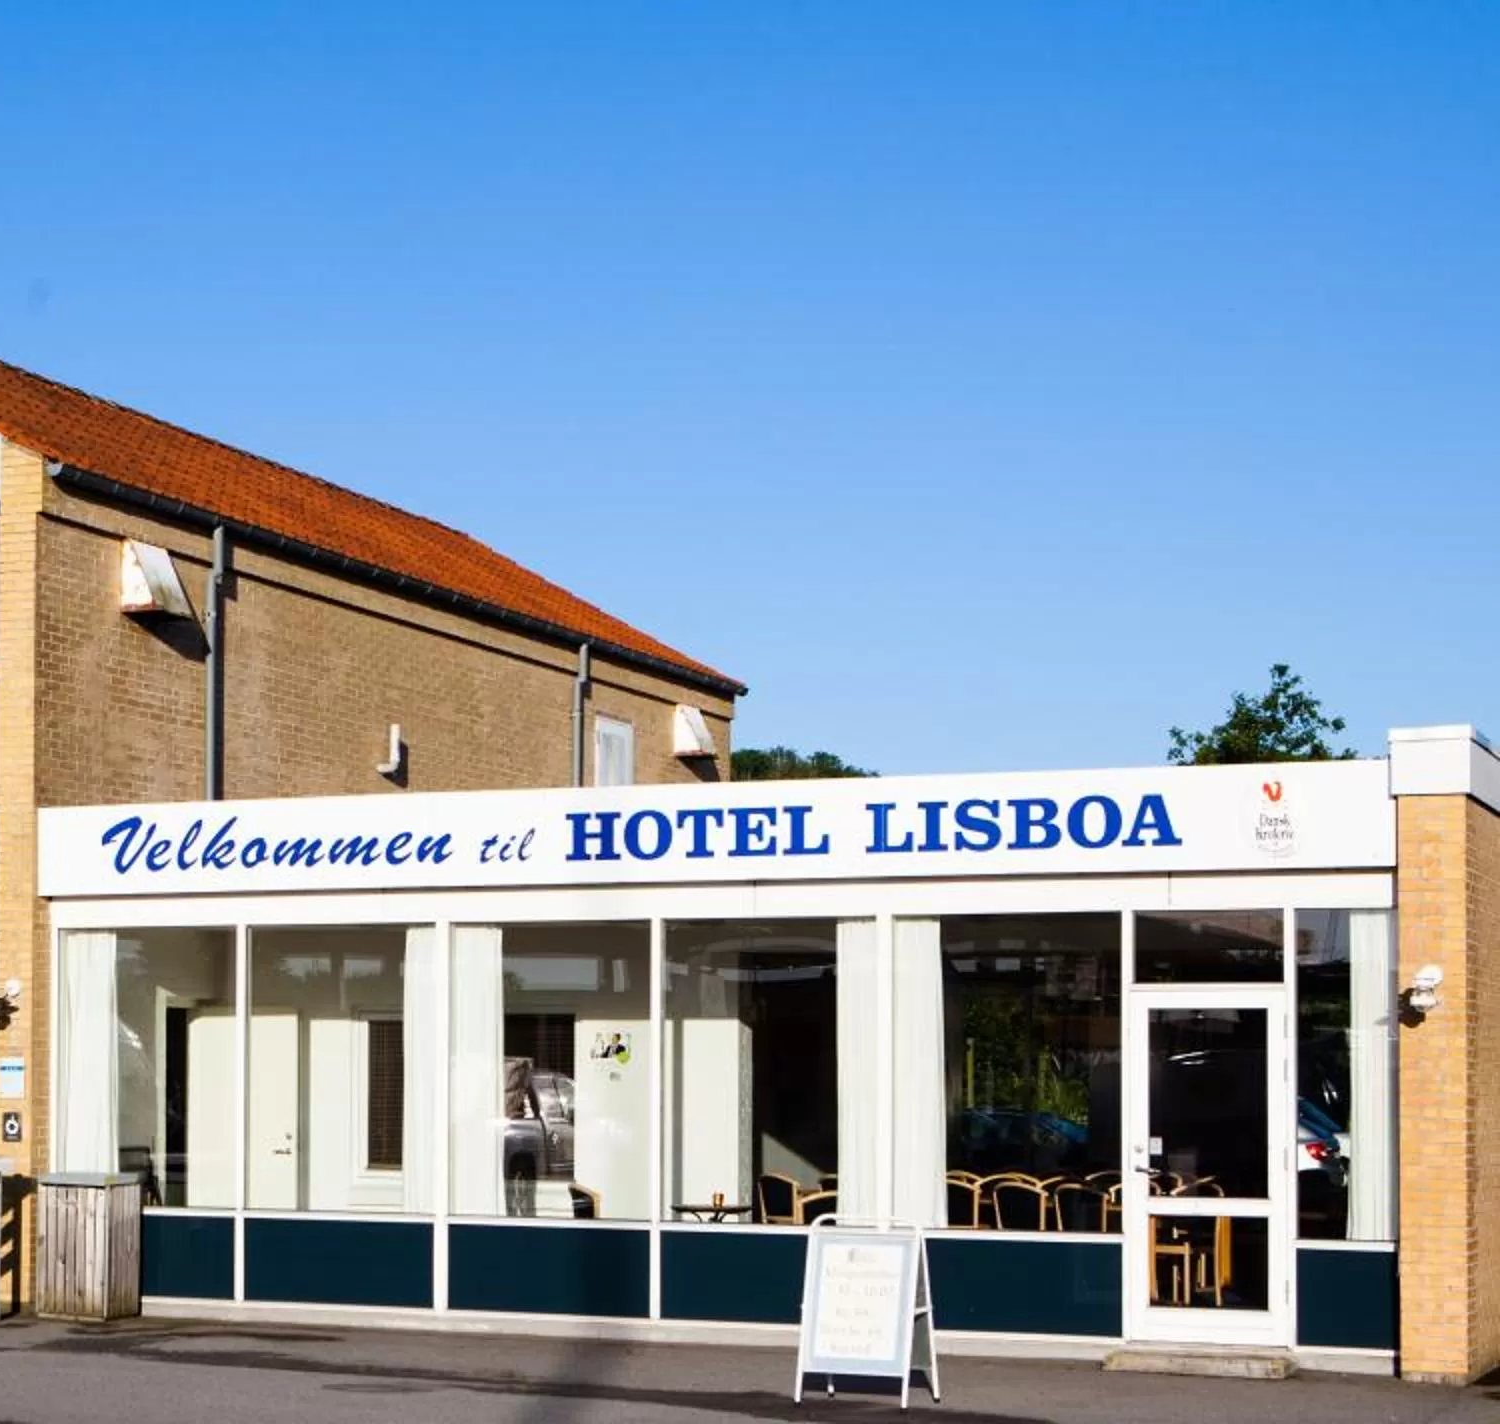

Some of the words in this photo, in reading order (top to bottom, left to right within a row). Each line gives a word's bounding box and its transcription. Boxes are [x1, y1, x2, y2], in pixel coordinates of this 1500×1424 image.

[101, 815, 453, 874] Velkommen
[479, 828, 535, 863] til
[565, 805, 830, 861] HOTEL
[865, 793, 1183, 853] LISBOA
